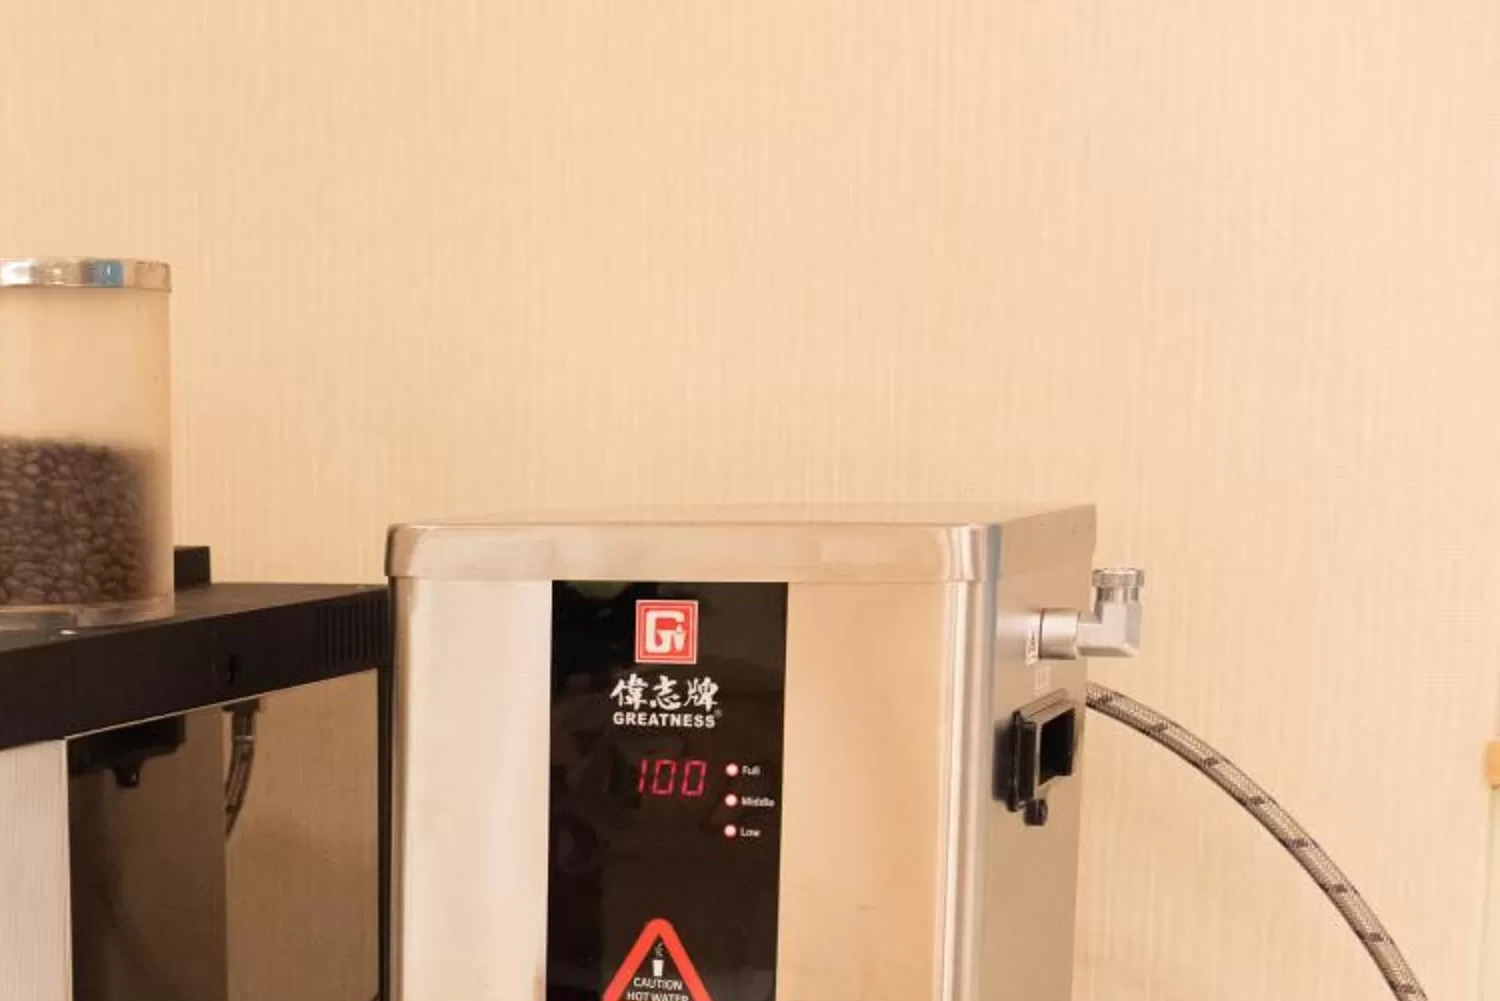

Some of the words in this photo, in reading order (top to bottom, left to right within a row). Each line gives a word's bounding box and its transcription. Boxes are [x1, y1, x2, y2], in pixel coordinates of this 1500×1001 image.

[610, 673, 719, 712] 偉志牌
[613, 711, 716, 728] GREATNESS
[741, 765, 761, 776] Full
[638, 758, 707, 797] 100
[741, 796, 775, 807] Middle
[740, 826, 761, 838] Low
[633, 977, 683, 990] CAUTION
[627, 991, 650, 1001] HOT
